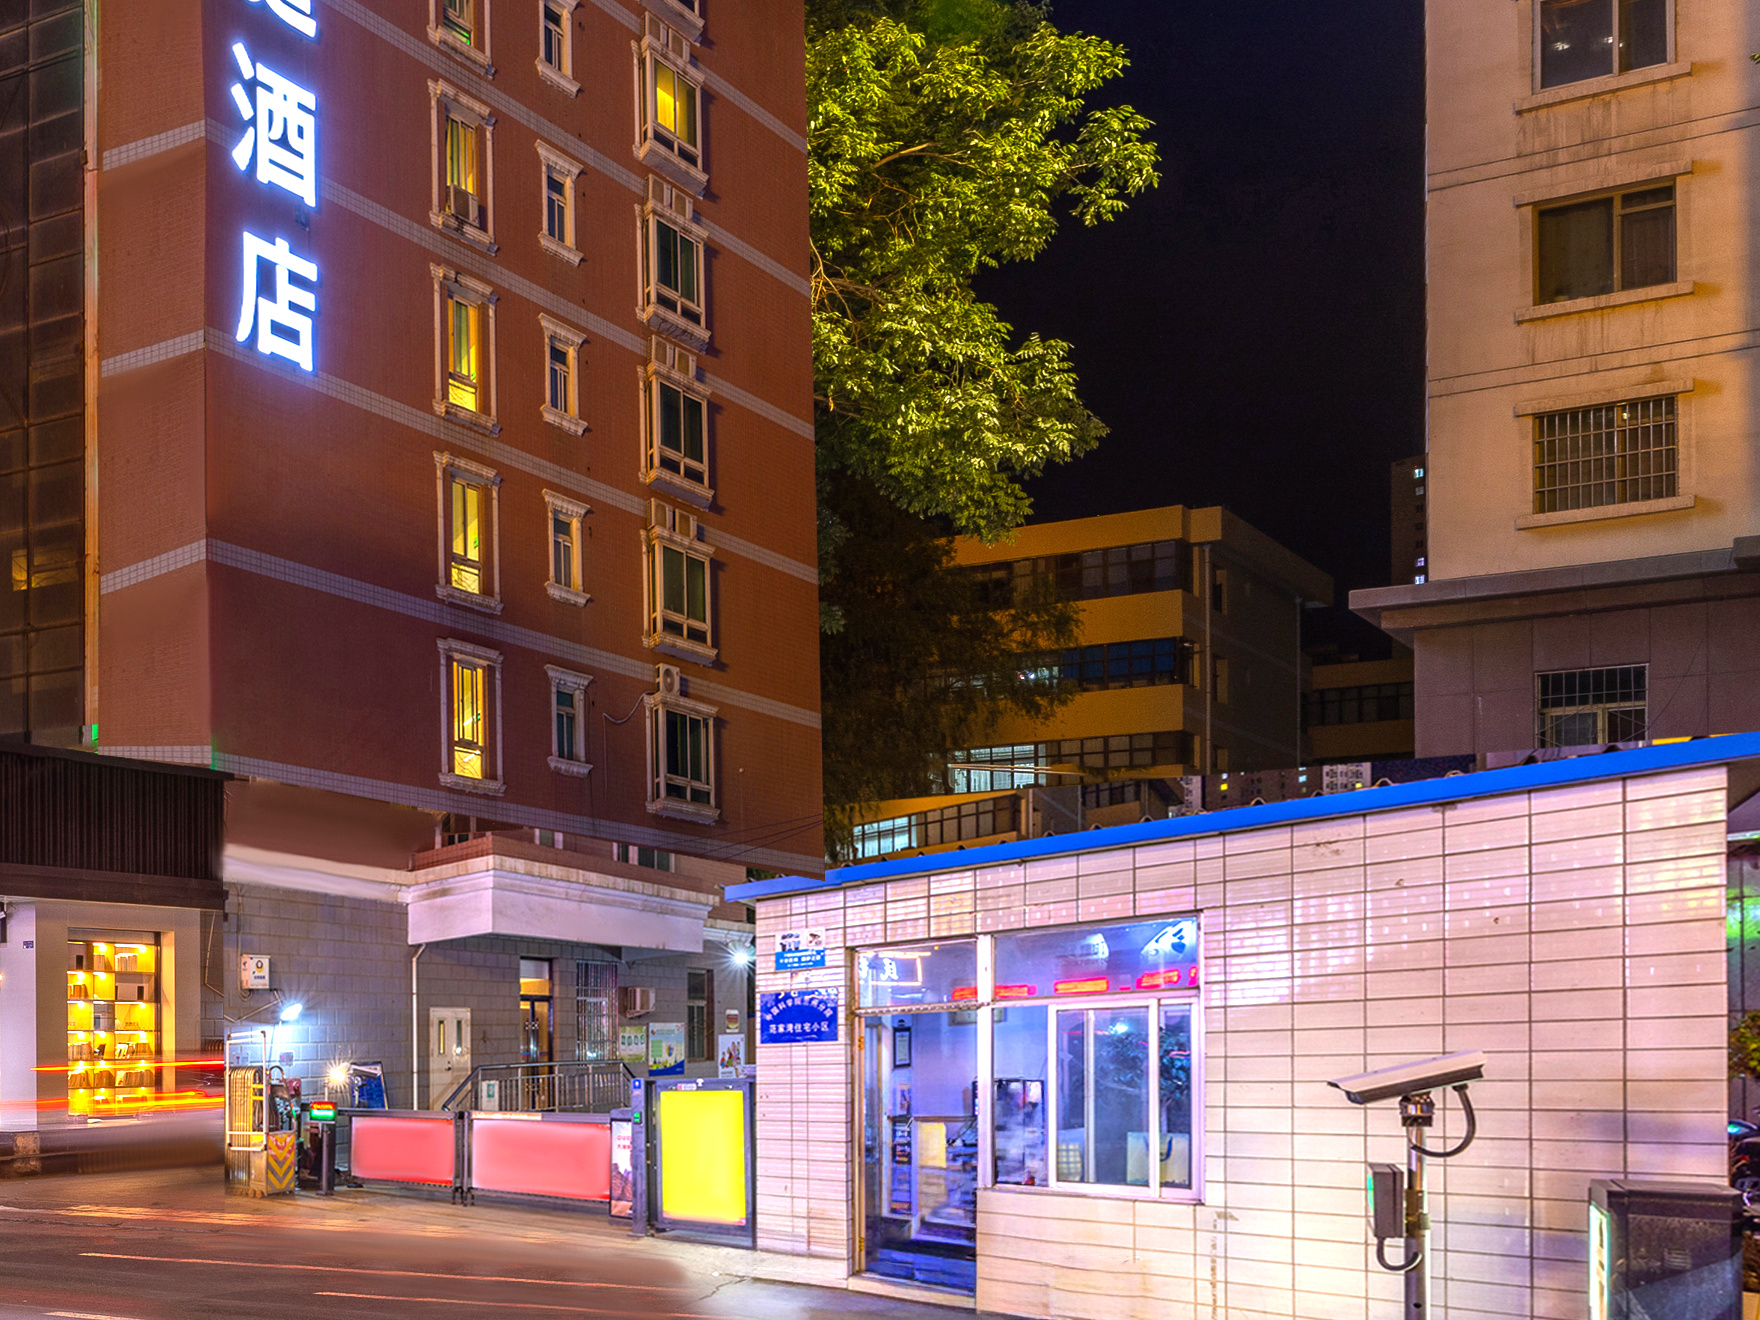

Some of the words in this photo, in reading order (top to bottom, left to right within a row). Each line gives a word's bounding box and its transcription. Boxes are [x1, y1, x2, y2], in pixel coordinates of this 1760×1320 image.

[769, 1021, 830, 1034] 范家湾住宅小区
